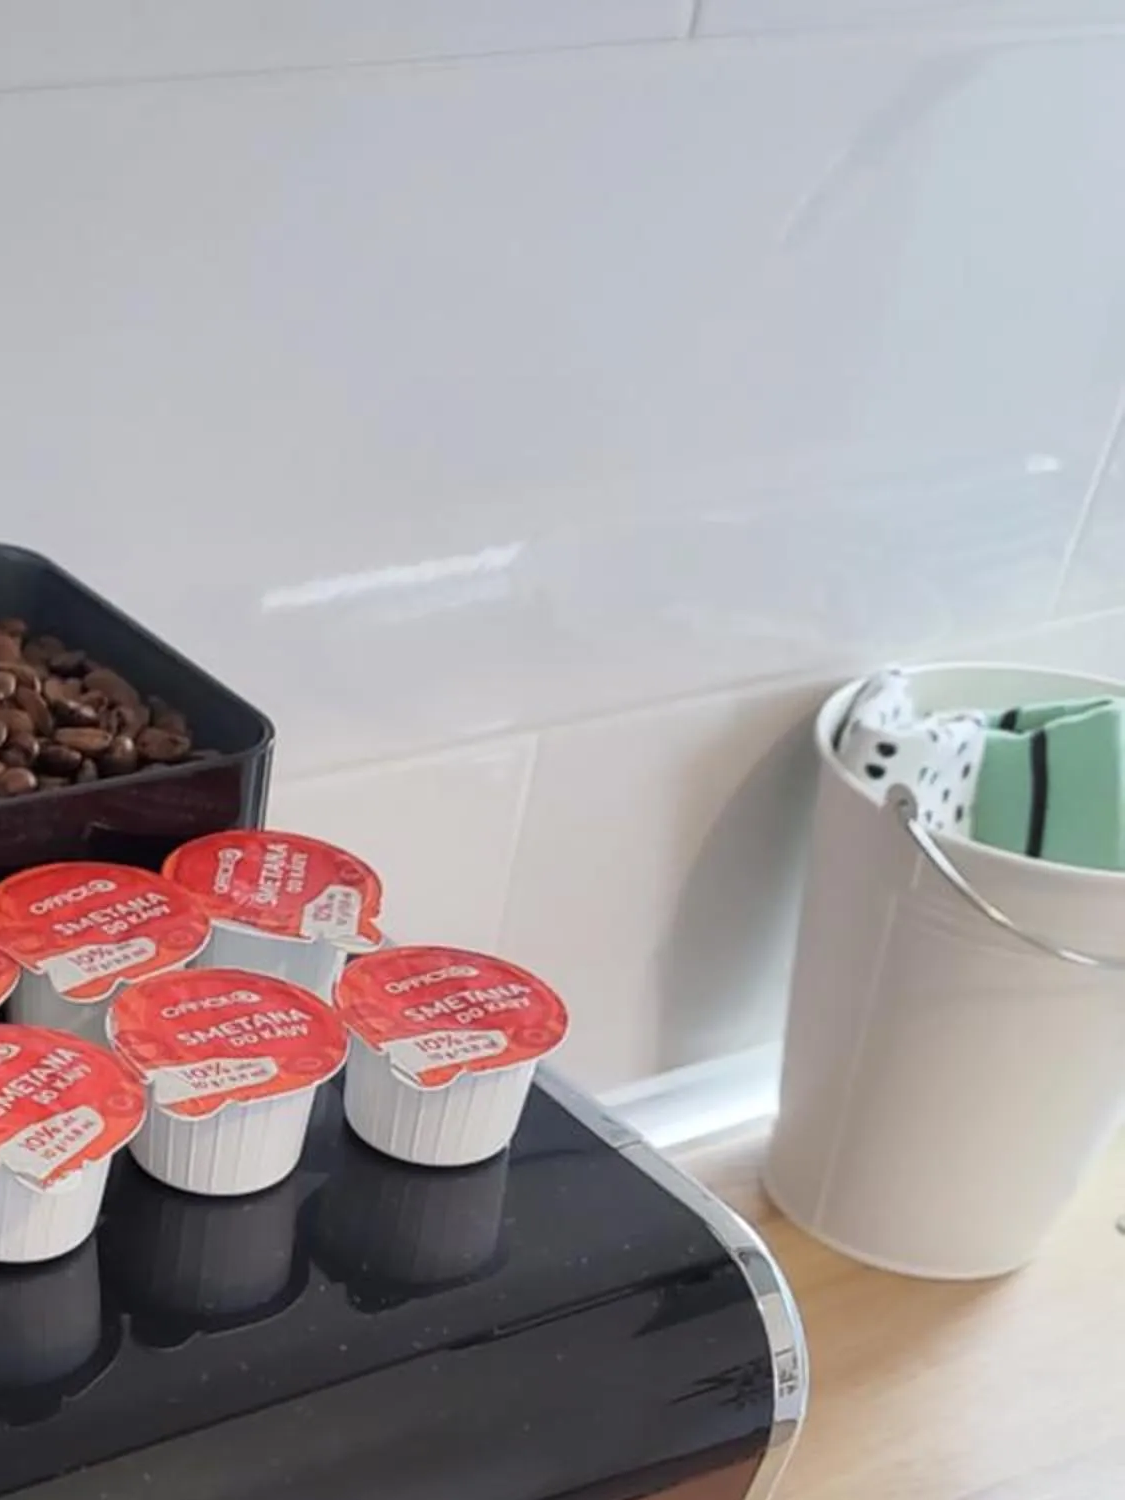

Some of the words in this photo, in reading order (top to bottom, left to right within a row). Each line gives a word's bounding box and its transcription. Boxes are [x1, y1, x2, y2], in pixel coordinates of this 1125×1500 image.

[52, 891, 169, 936] SMETANA
[403, 983, 532, 1022] SMETANA
[177, 1008, 313, 1046] SMETANA
